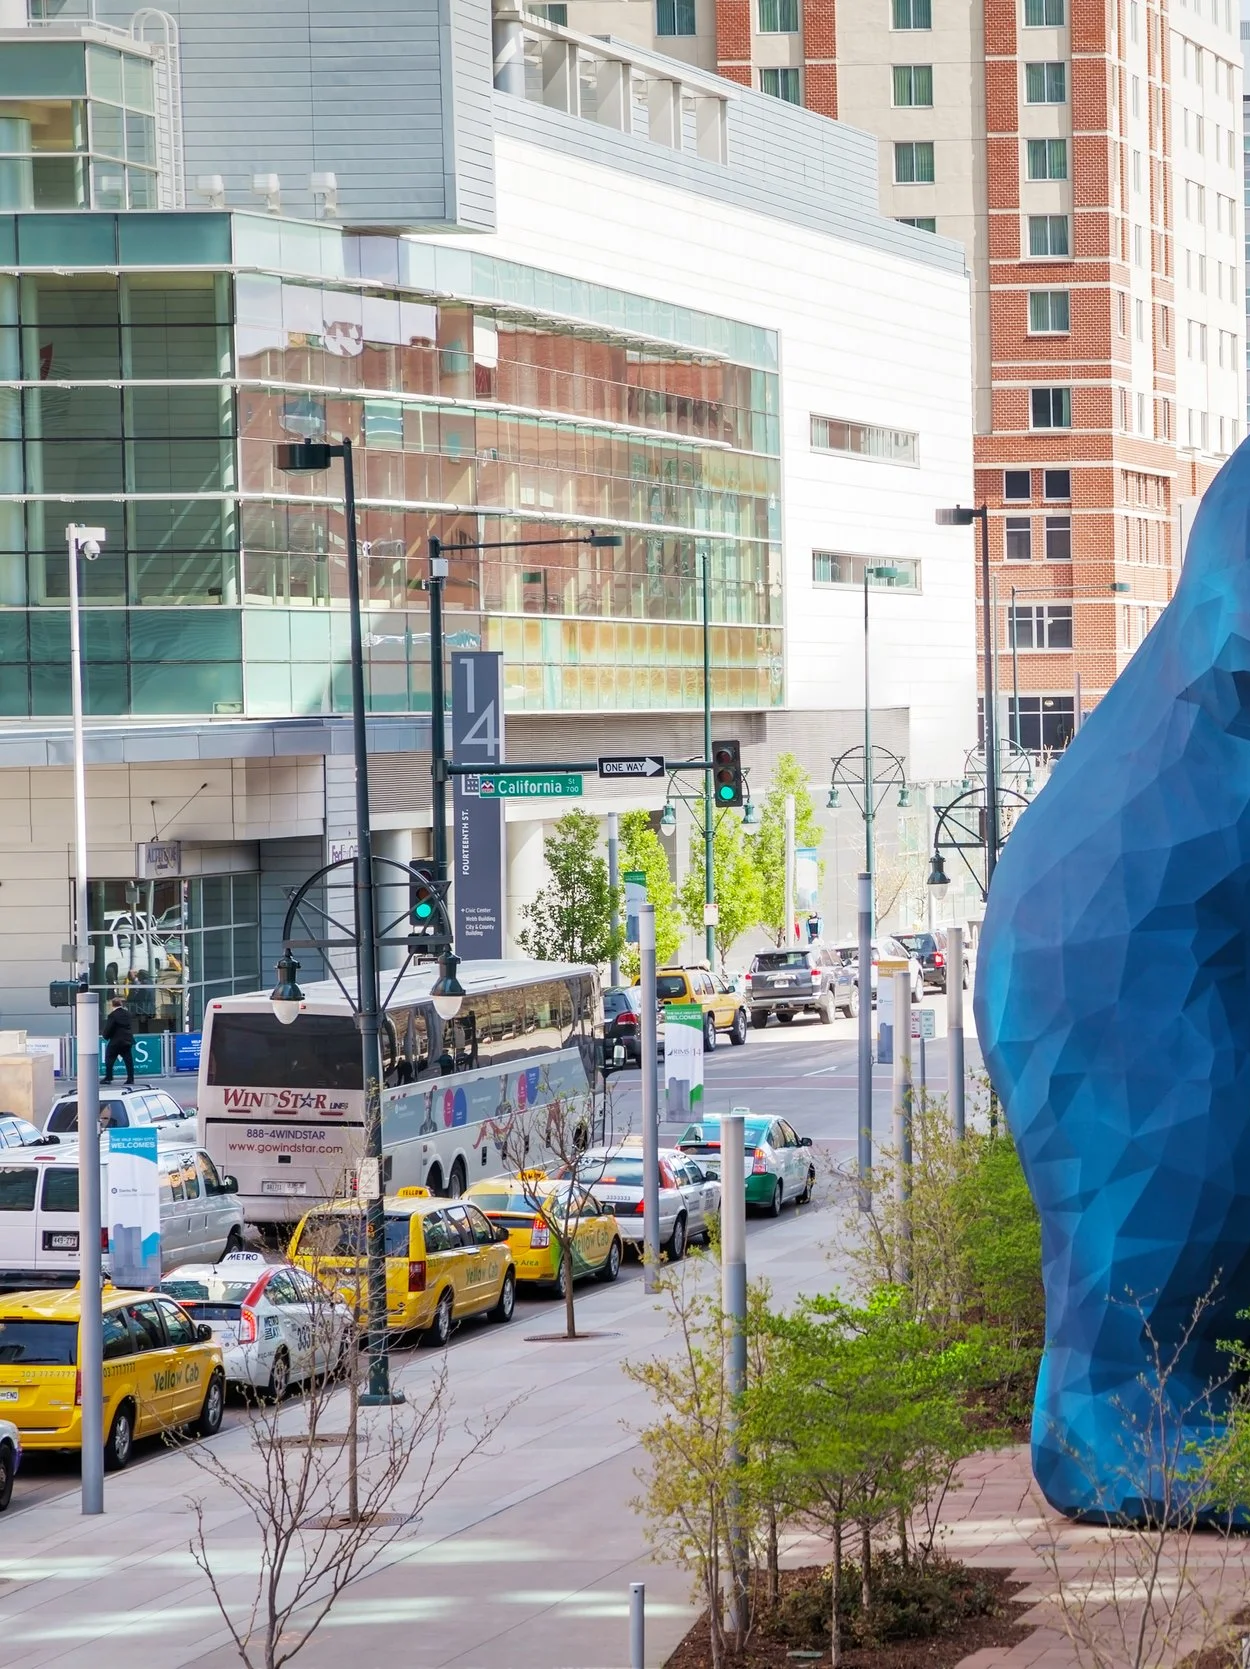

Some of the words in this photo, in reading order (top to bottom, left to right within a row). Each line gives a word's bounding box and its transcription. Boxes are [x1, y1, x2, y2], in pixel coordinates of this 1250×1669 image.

[605, 763, 624, 773] ONE
[626, 762, 645, 773] WAY
[497, 780, 563, 795] California
[462, 809, 470, 821] ST.
[462, 823, 470, 875] FOURTEENTH
[246, 1129, 326, 1140] 888-4WINDSTAR
[111, 1141, 156, 1149] WELCOMES
[228, 1143, 344, 1154] www.gowindstar.com
[227, 1253, 259, 1261] METRO
[520, 1259, 539, 1267] Area
[488, 1261, 499, 1279] Cab
[227, 1282, 252, 1290] 194
[153, 1371, 183, 1394] Yellow
[184, 1361, 200, 1385] Cab
